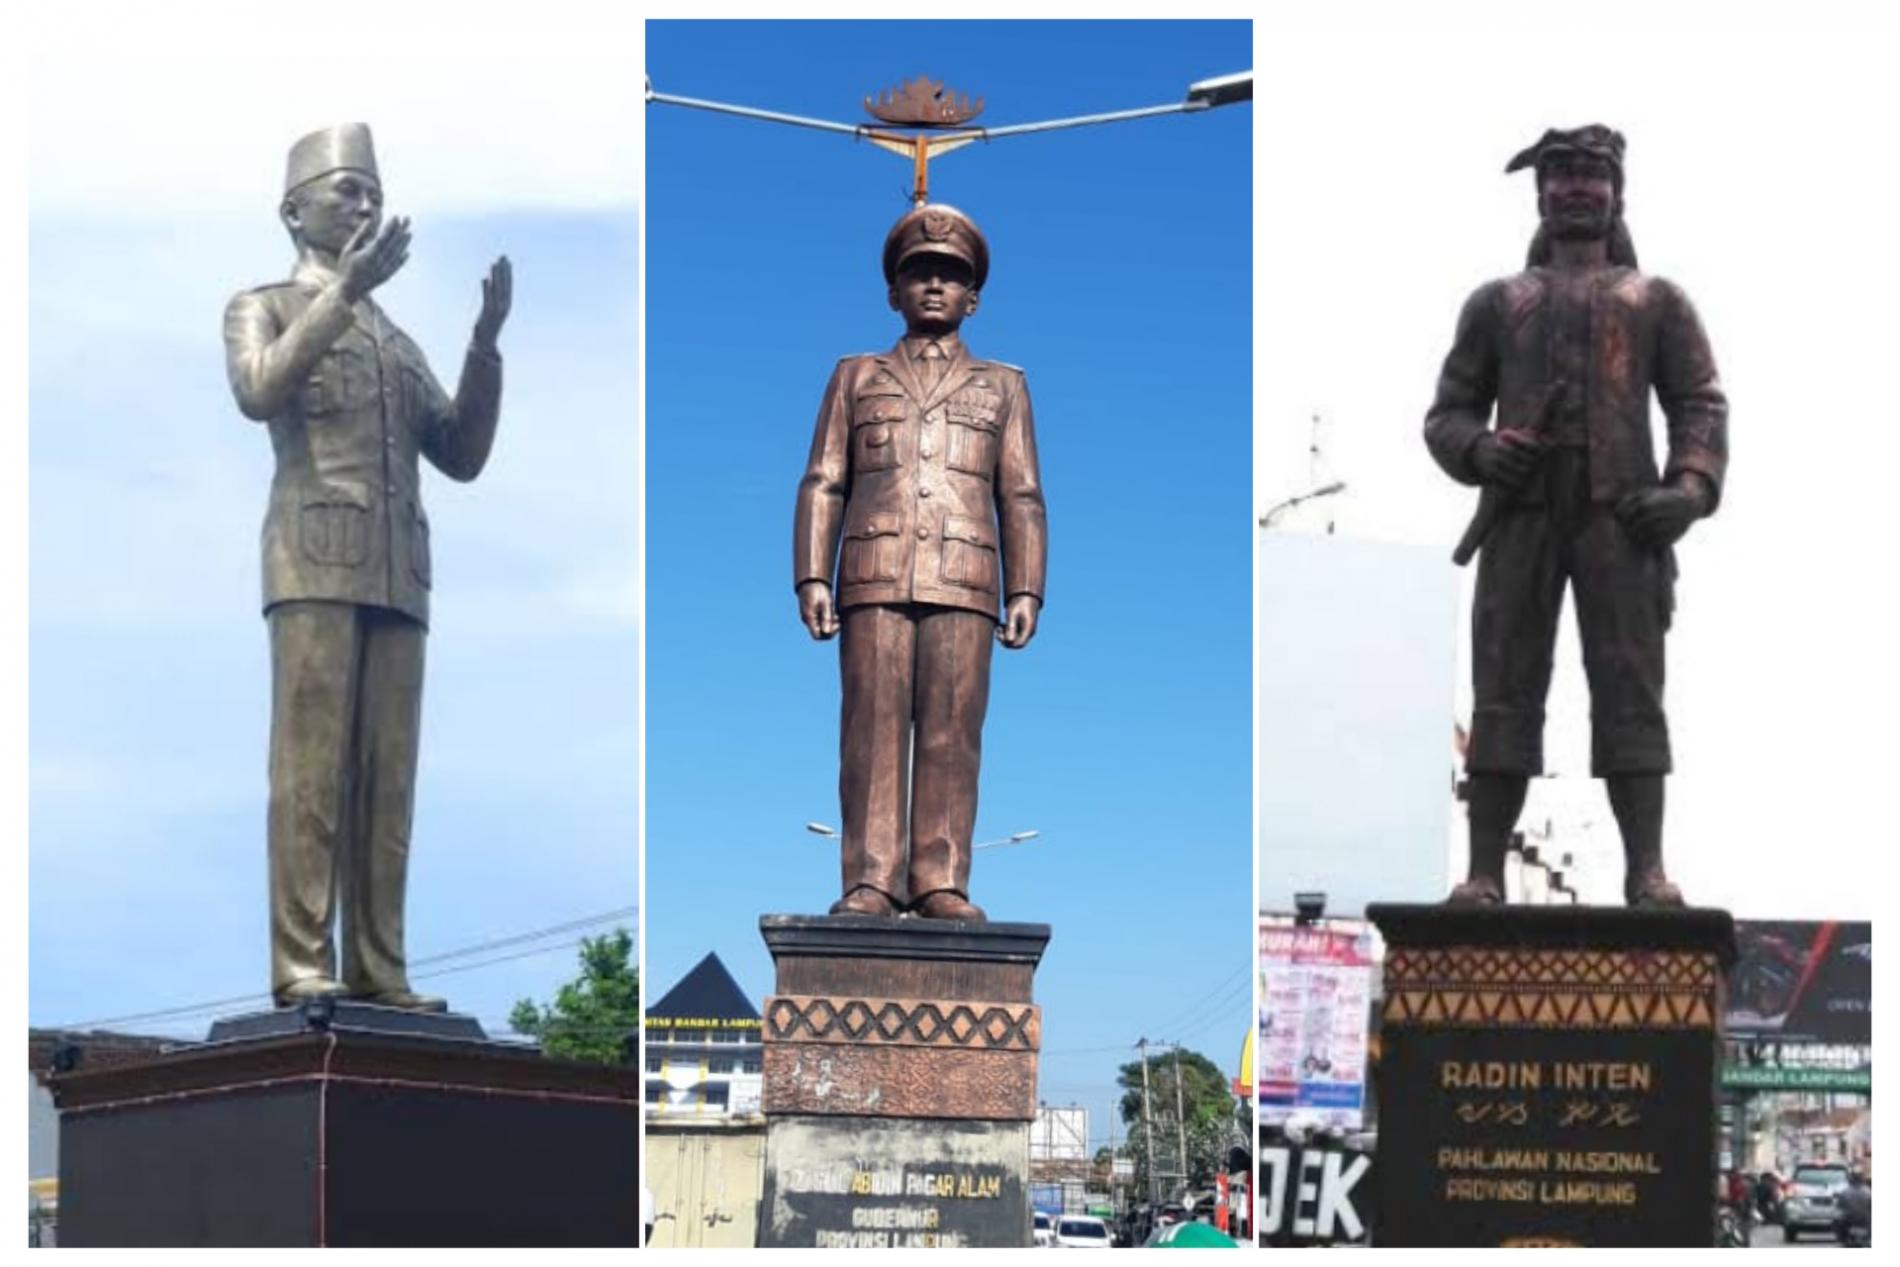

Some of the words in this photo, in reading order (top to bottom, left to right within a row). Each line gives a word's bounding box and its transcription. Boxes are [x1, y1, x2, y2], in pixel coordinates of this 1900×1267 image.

[1442, 1062, 1540, 1090] RADIN
[1554, 1063, 1650, 1090] INTEN
[1438, 1149, 1549, 1170] PAHLAWAN
[1555, 1152, 1661, 1174] NASIONAL
[956, 1174, 1001, 1199] ALAM
[1447, 1180, 1536, 1201] PROVINSI
[1540, 1182, 1637, 1205] LAMPUNG
